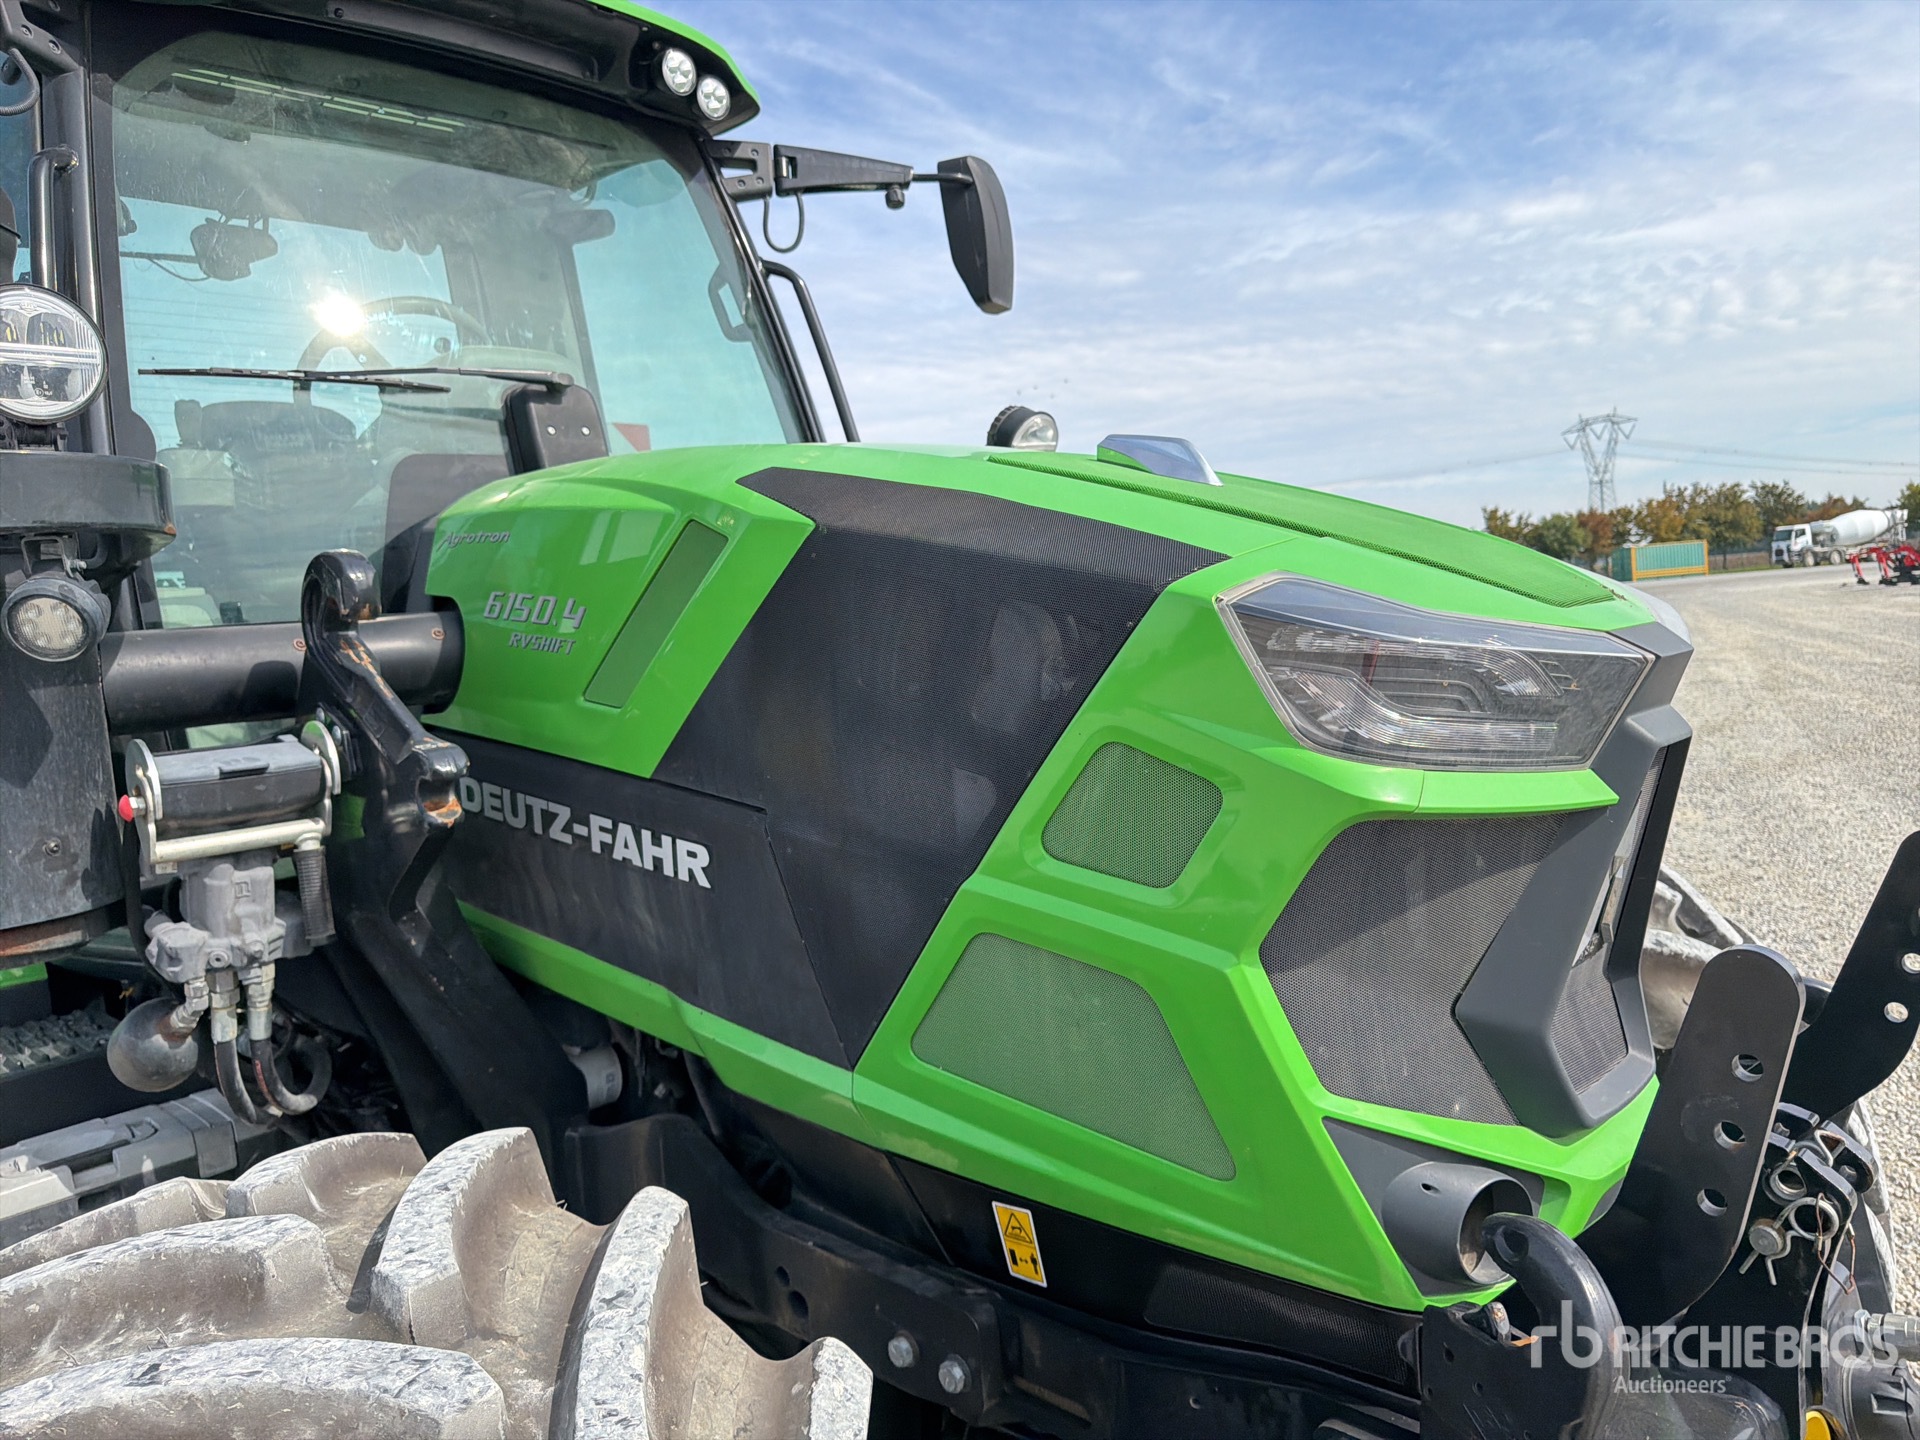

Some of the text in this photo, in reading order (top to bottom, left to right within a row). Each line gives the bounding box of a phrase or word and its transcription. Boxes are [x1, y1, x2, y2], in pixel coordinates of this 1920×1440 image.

[436, 530, 511, 551] Agrotron
[483, 591, 587, 629] 6150.4
[508, 632, 576, 655] RVSHIFT
[459, 776, 712, 889] DEUTZ-FAHR
